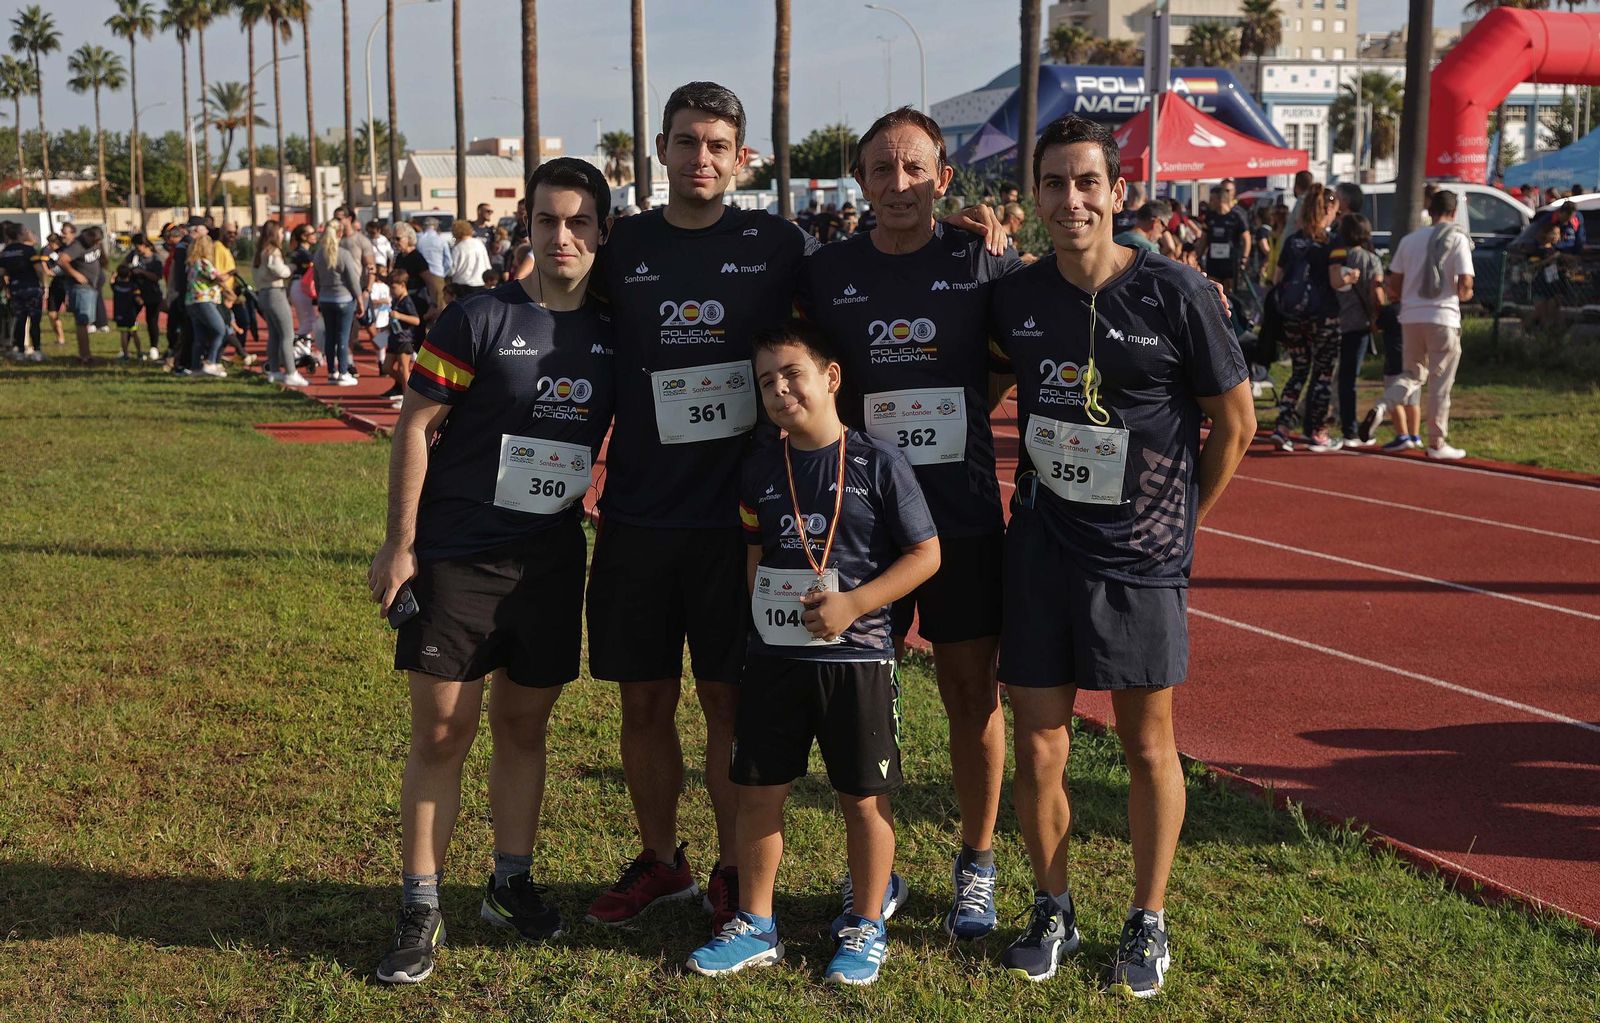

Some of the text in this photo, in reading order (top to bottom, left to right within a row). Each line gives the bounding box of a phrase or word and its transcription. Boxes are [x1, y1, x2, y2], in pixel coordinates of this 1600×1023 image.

[1163, 162, 1205, 172] Santander
[1257, 158, 1298, 168] Santander
[740, 262, 767, 274] mupol
[624, 274, 660, 284] Santander
[952, 280, 979, 291] mupol
[832, 295, 869, 305] Santander
[659, 300, 725, 326] 200
[868, 317, 937, 346] 200
[1012, 328, 1045, 337] Santander
[660, 337, 725, 345] NACIONAL
[1127, 333, 1159, 346] mupol
[498, 348, 539, 356] Santander
[870, 347, 924, 356] POLICIA
[871, 354, 938, 364] NACIONAL
[536, 376, 593, 403] 200
[692, 385, 722, 394] Santander
[533, 405, 578, 413] POLICIA
[688, 403, 727, 424] 361
[532, 411, 588, 421] NACIONAL
[897, 428, 937, 448] 362
[1059, 443, 1090, 453] Santander
[539, 459, 567, 469] Santander
[1050, 461, 1090, 484] 359
[528, 478, 566, 498] 360
[845, 486, 869, 499] mupol
[773, 589, 802, 598] Santander
[764, 608, 805, 628] 104
